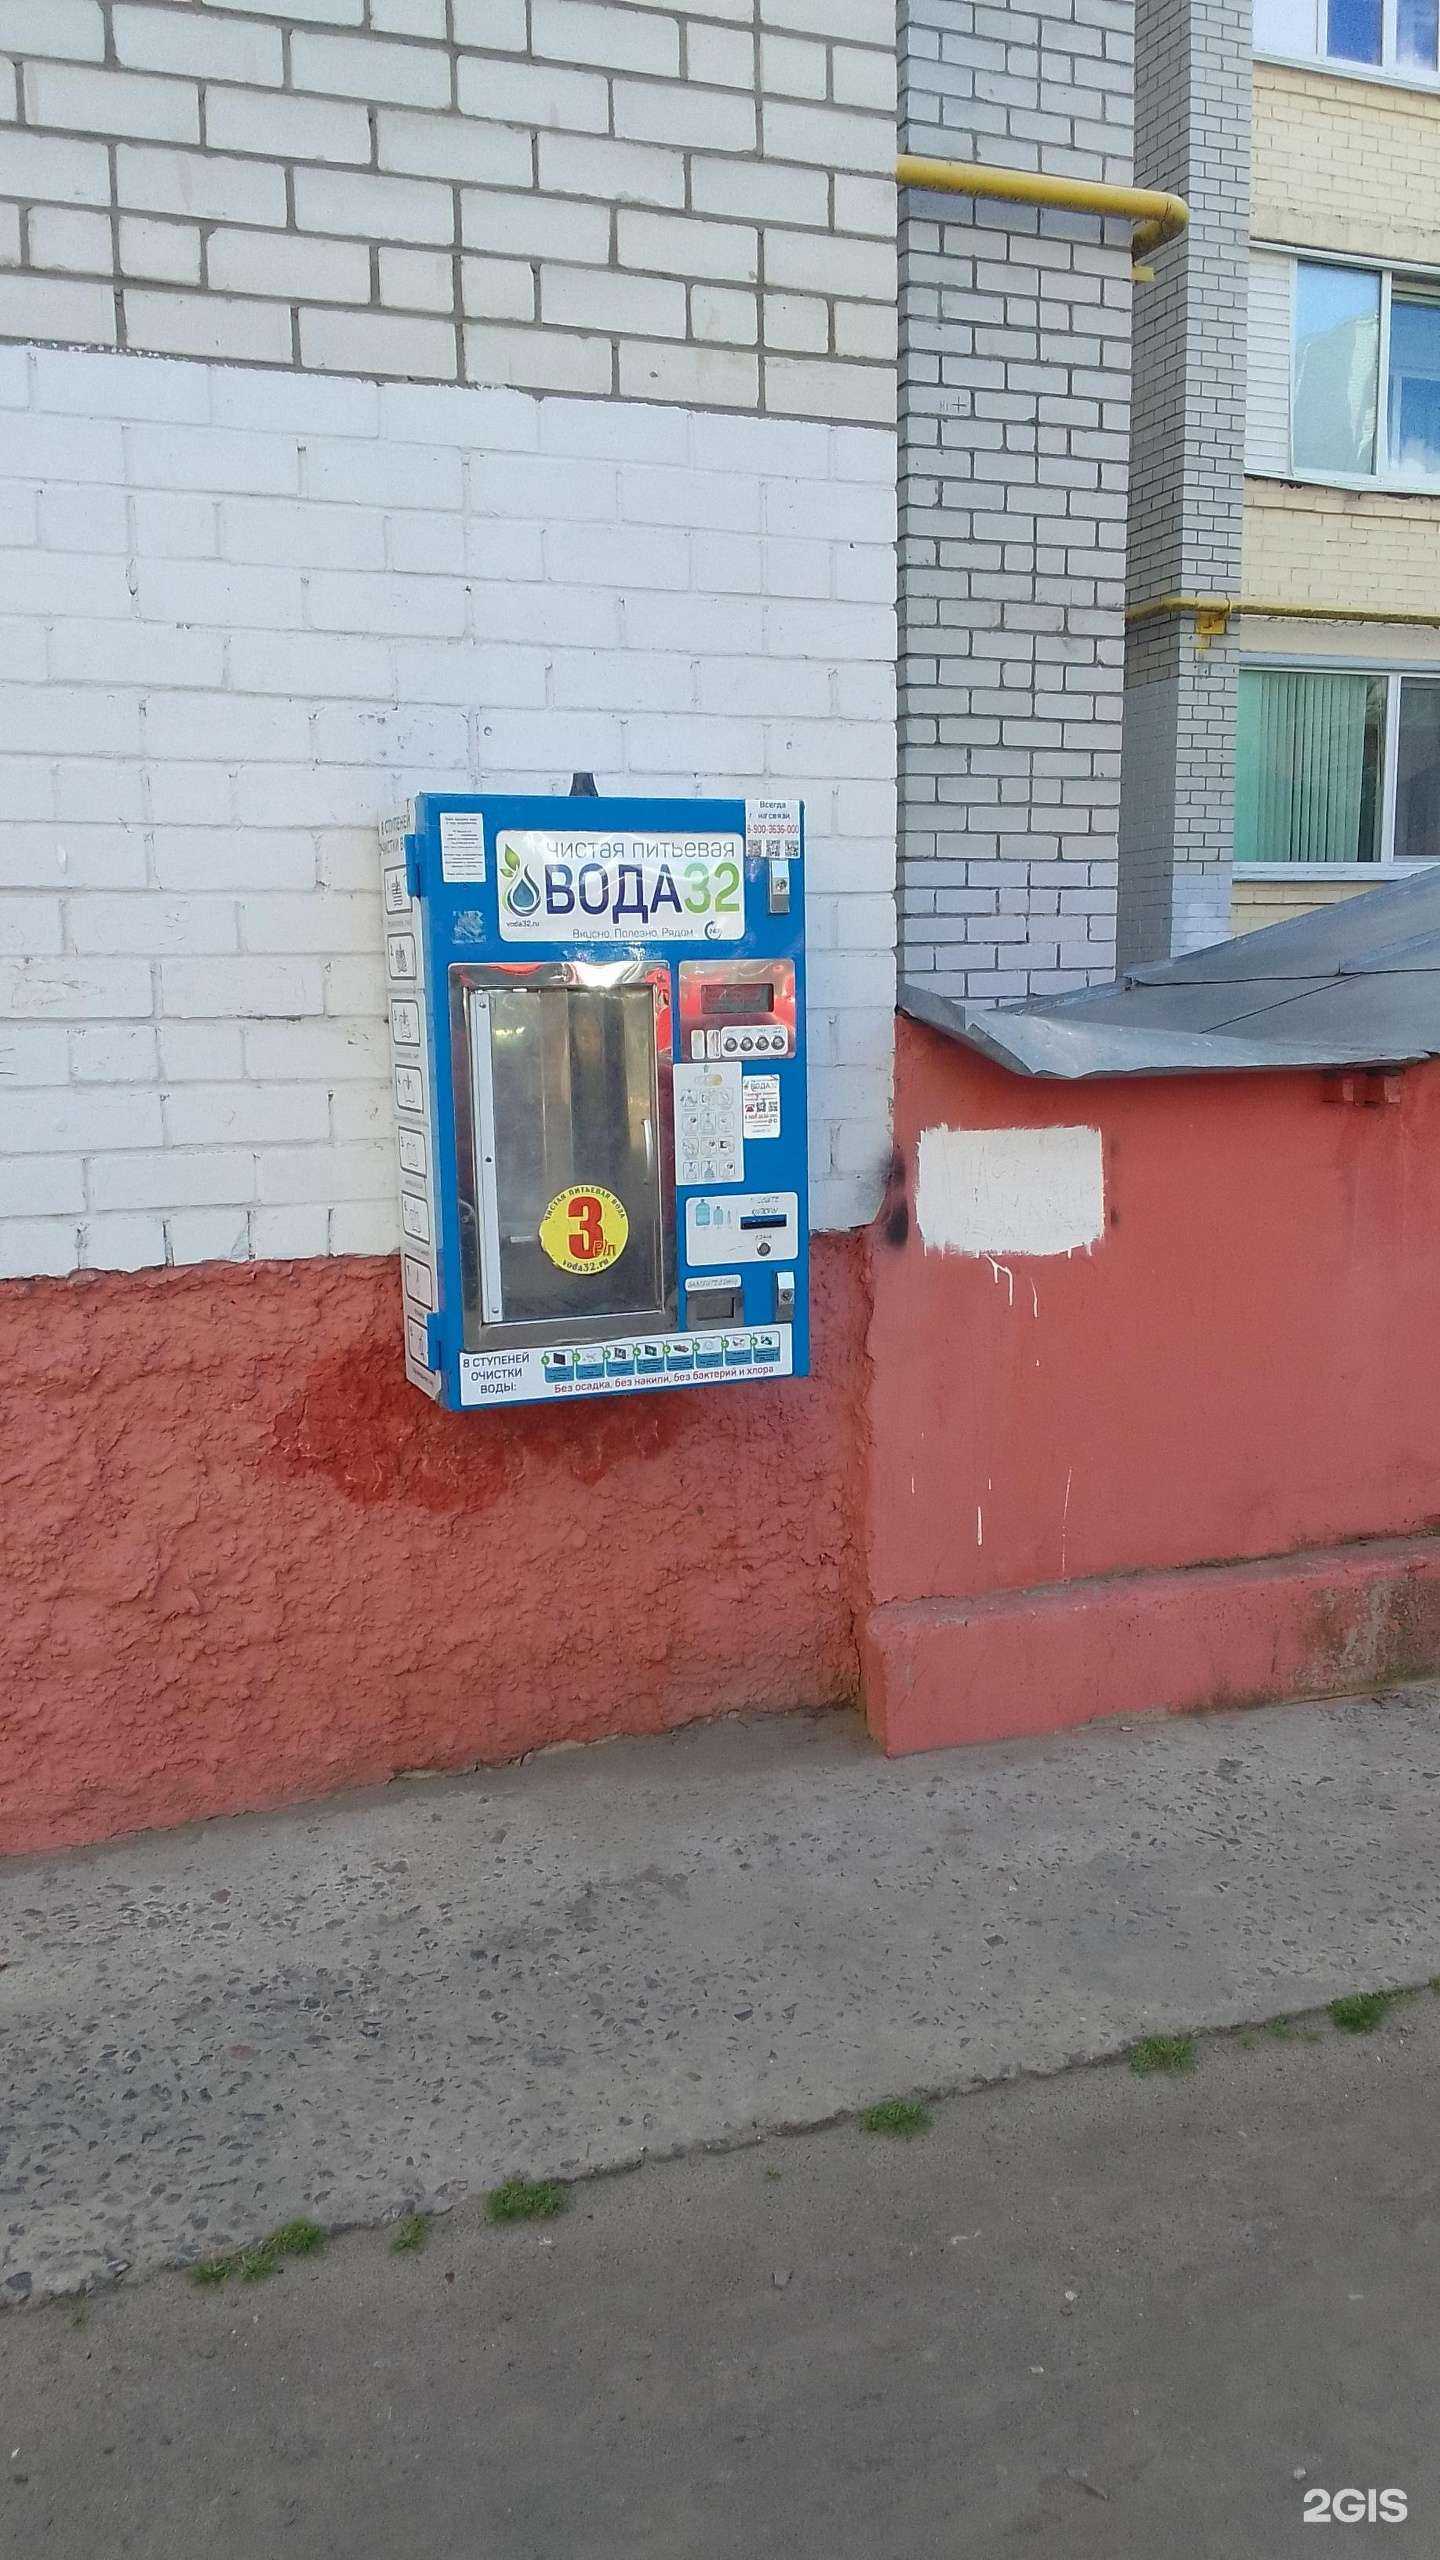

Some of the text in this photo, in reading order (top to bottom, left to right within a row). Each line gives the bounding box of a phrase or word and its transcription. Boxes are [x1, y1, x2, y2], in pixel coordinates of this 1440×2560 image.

[759, 801, 786, 809] Всегда
[632, 841, 736, 859] питьевая
[545, 862, 740, 924] ВОДА32
[568, 1186, 612, 1200] ПИТЬЕВАЯ
[610, 1198, 626, 1219] ВОДА
[567, 1196, 605, 1259] 3
[562, 1258, 609, 1272] voda32.ru
[462, 1352, 530, 1368] 8 СТУПЕНЕЙ
[470, 1367, 523, 1381] ОЧИСТКИ
[554, 1384, 573, 1393] Без
[614, 1378, 632, 1387] без
[674, 1372, 691, 1382] без
[693, 1368, 737, 1381] бактерий
[747, 1364, 774, 1376] хлора
[480, 1383, 517, 1394] ВОДЫ:
